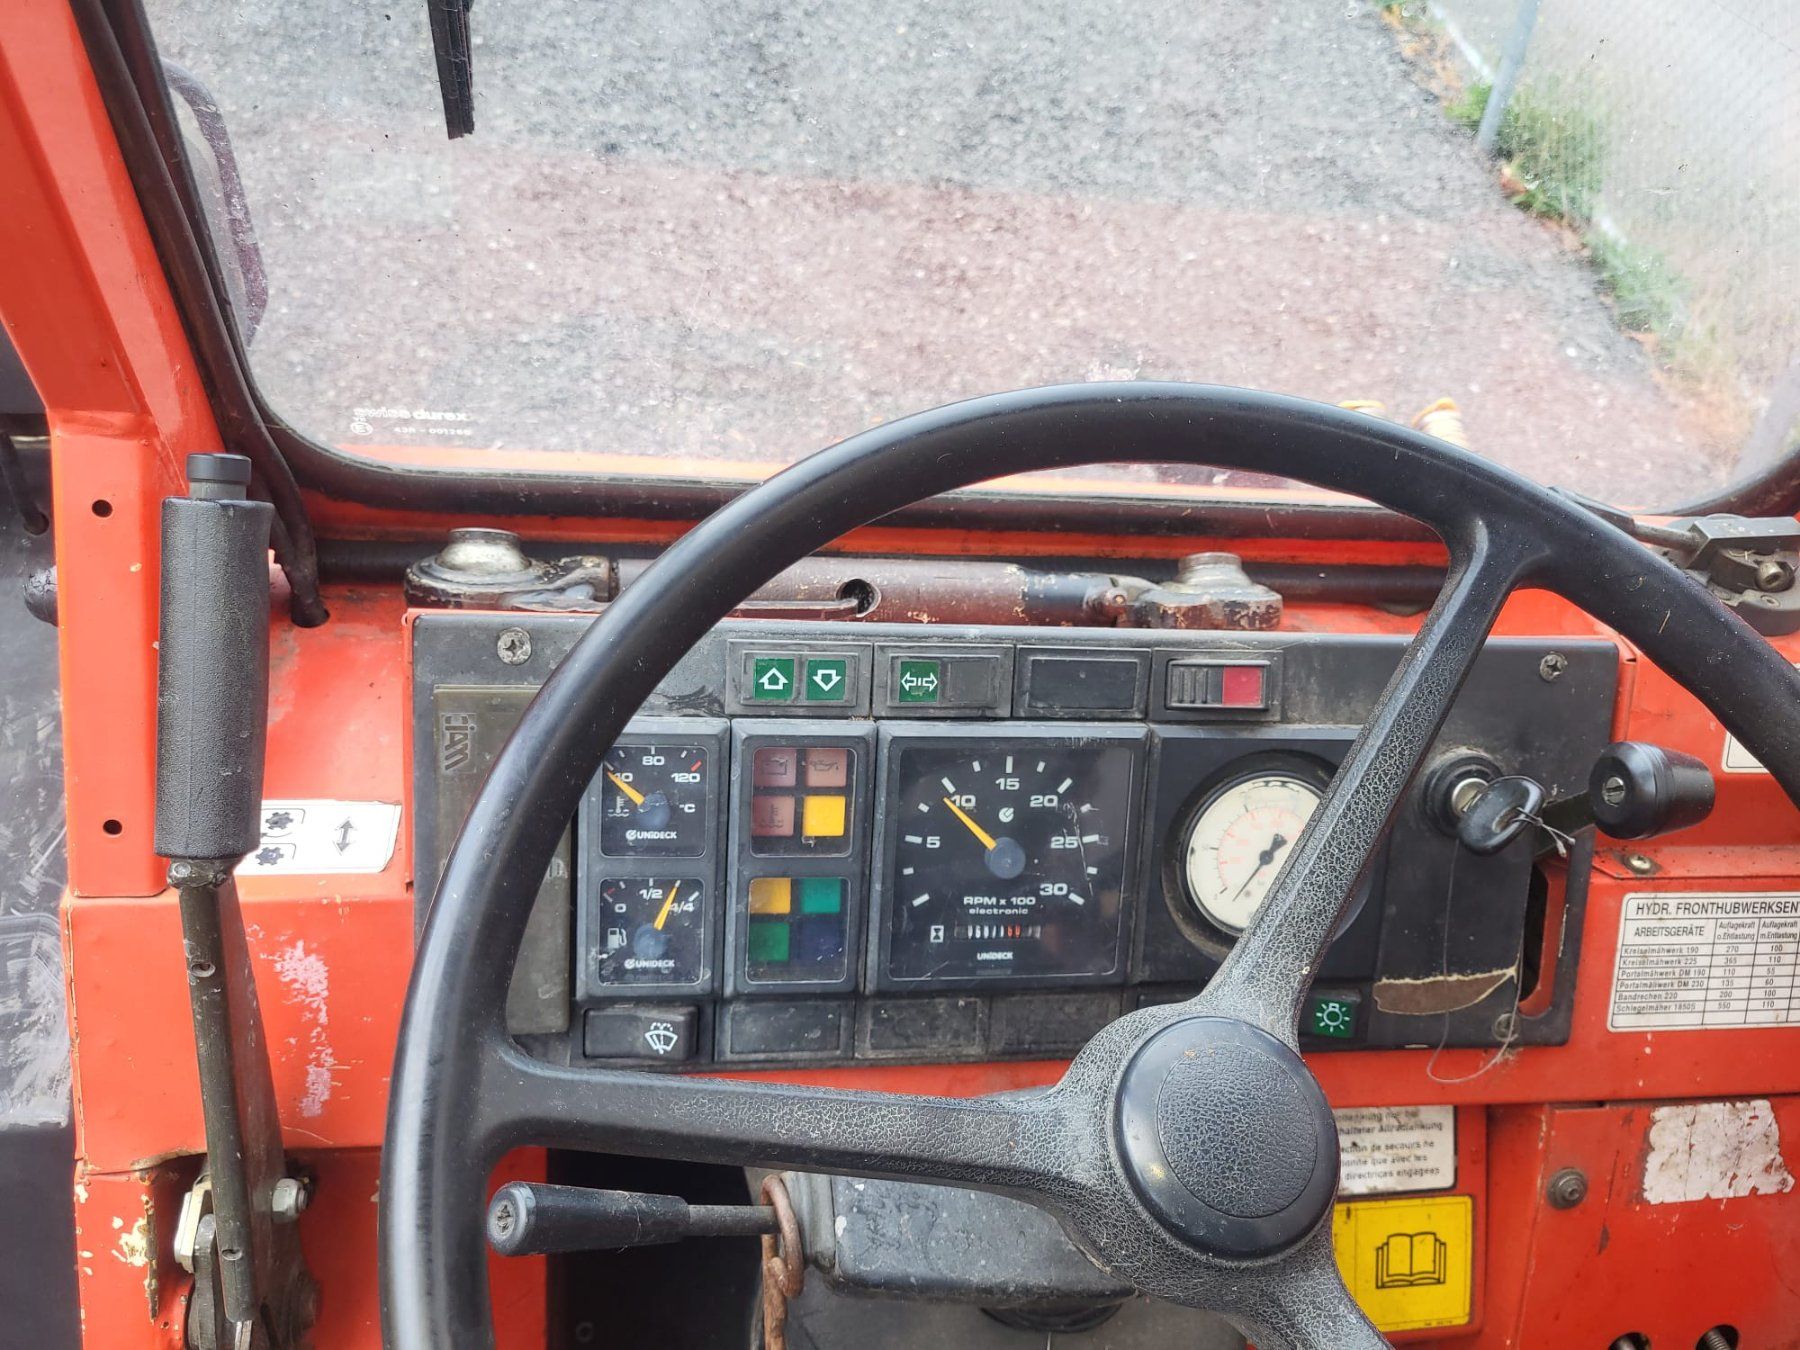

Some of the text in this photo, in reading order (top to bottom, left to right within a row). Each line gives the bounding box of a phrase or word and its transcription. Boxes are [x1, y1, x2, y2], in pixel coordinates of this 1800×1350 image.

[642, 755, 665, 766] 80
[671, 772, 701, 783] 120
[995, 778, 1020, 791] 15
[950, 795, 976, 808] 10
[1030, 795, 1058, 807] 20
[637, 830, 677, 839] UNIDECK
[926, 836, 941, 848] 5
[1050, 836, 1078, 848] 25
[639, 888, 663, 900] 1/2
[1039, 883, 1068, 895] 30
[963, 896, 997, 906] RPM
[1010, 896, 1036, 906] 100
[614, 903, 627, 913] 0
[968, 907, 1029, 915] electronic
[1636, 901, 1800, 915] HYDR. FRONTHUBWERKSEN
[1686, 946, 1699, 954] 190
[1770, 944, 1783, 952] 100
[977, 951, 1013, 961] UNIDECK
[1768, 955, 1781, 963] 110
[635, 959, 675, 968] UNIDECK
[1677, 980, 1689, 988] DM
[1385, 1141, 1421, 1150] secours
